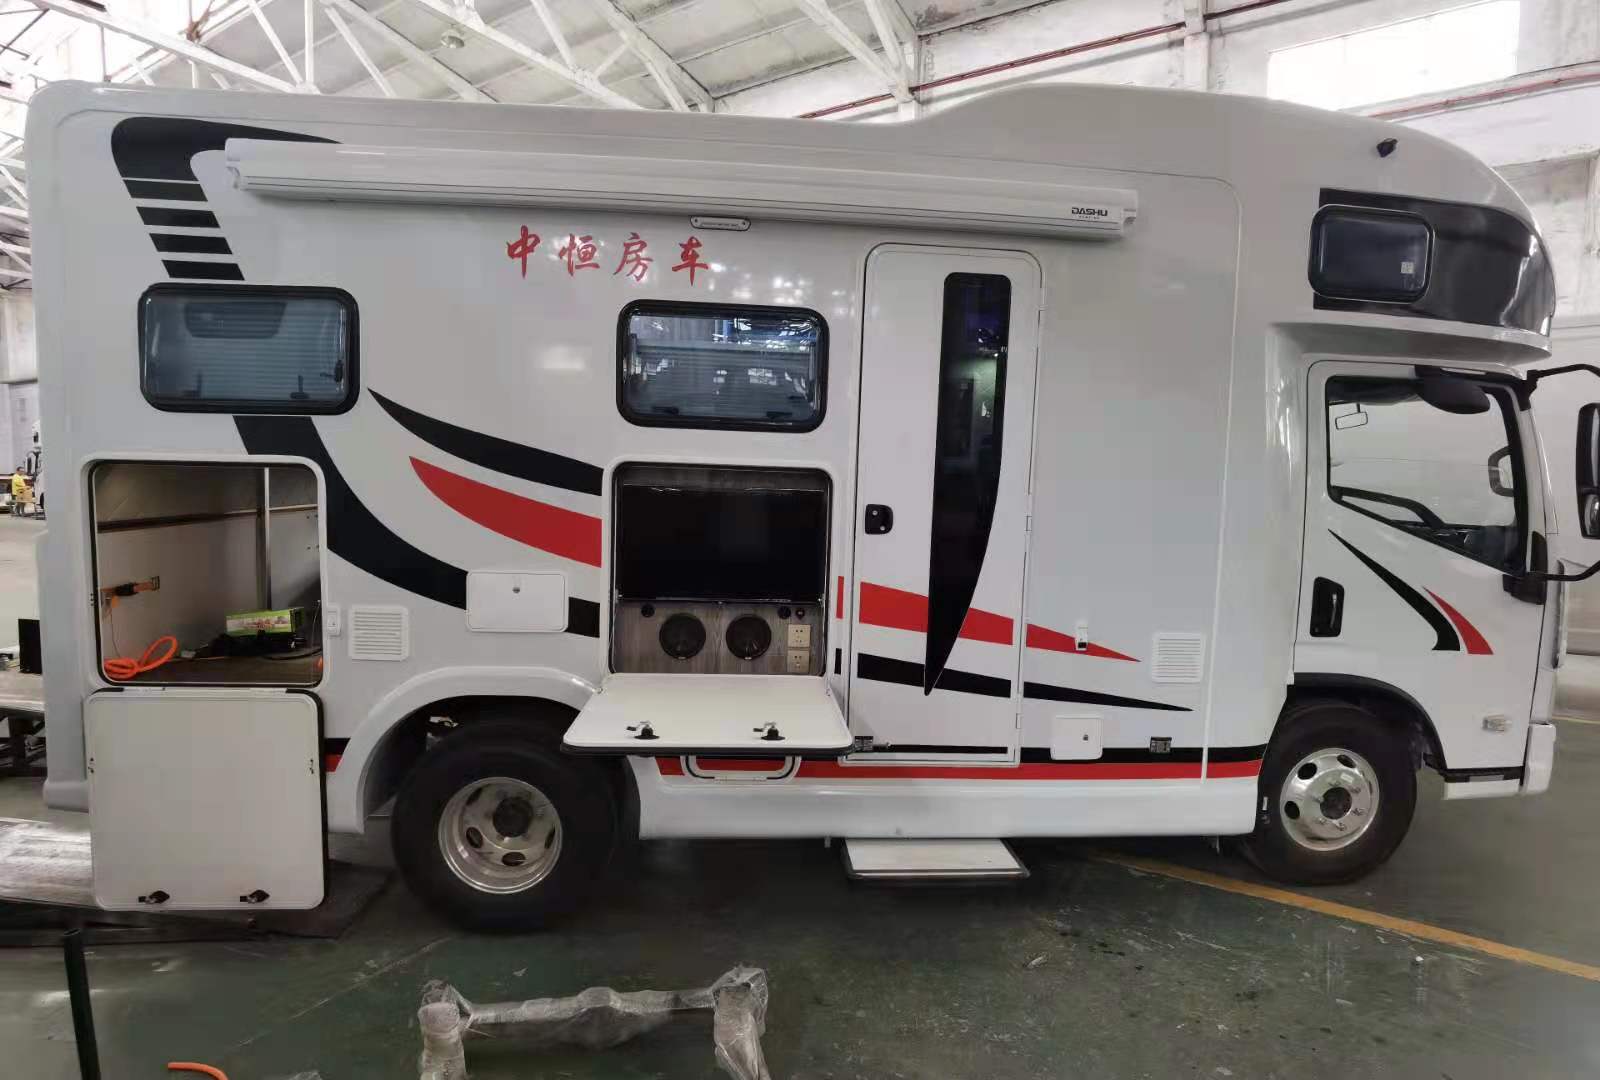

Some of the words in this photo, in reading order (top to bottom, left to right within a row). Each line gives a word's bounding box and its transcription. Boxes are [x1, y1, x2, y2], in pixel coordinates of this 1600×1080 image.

[1071, 206, 1108, 217] DASHU
[507, 225, 709, 286] 中恒房车
